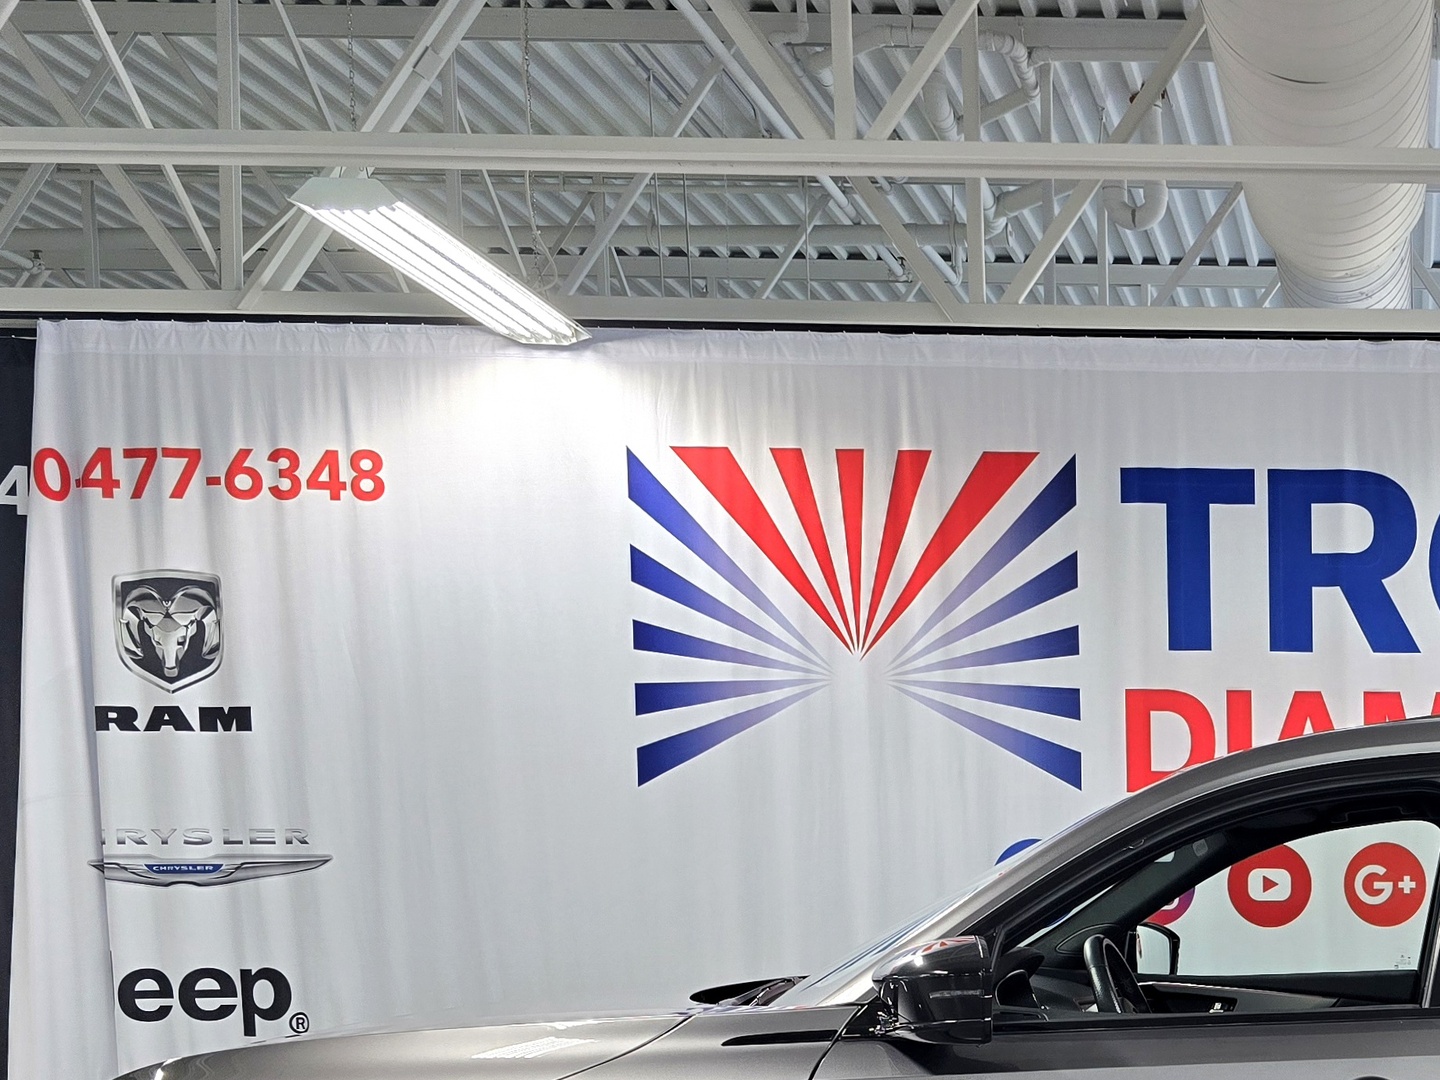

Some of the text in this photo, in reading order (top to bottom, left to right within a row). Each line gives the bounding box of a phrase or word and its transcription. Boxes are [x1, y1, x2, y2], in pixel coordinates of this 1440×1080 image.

[96, 706, 252, 732] RAM
[102, 828, 310, 846] RYSLER
[152, 864, 214, 872] CHRYSLER
